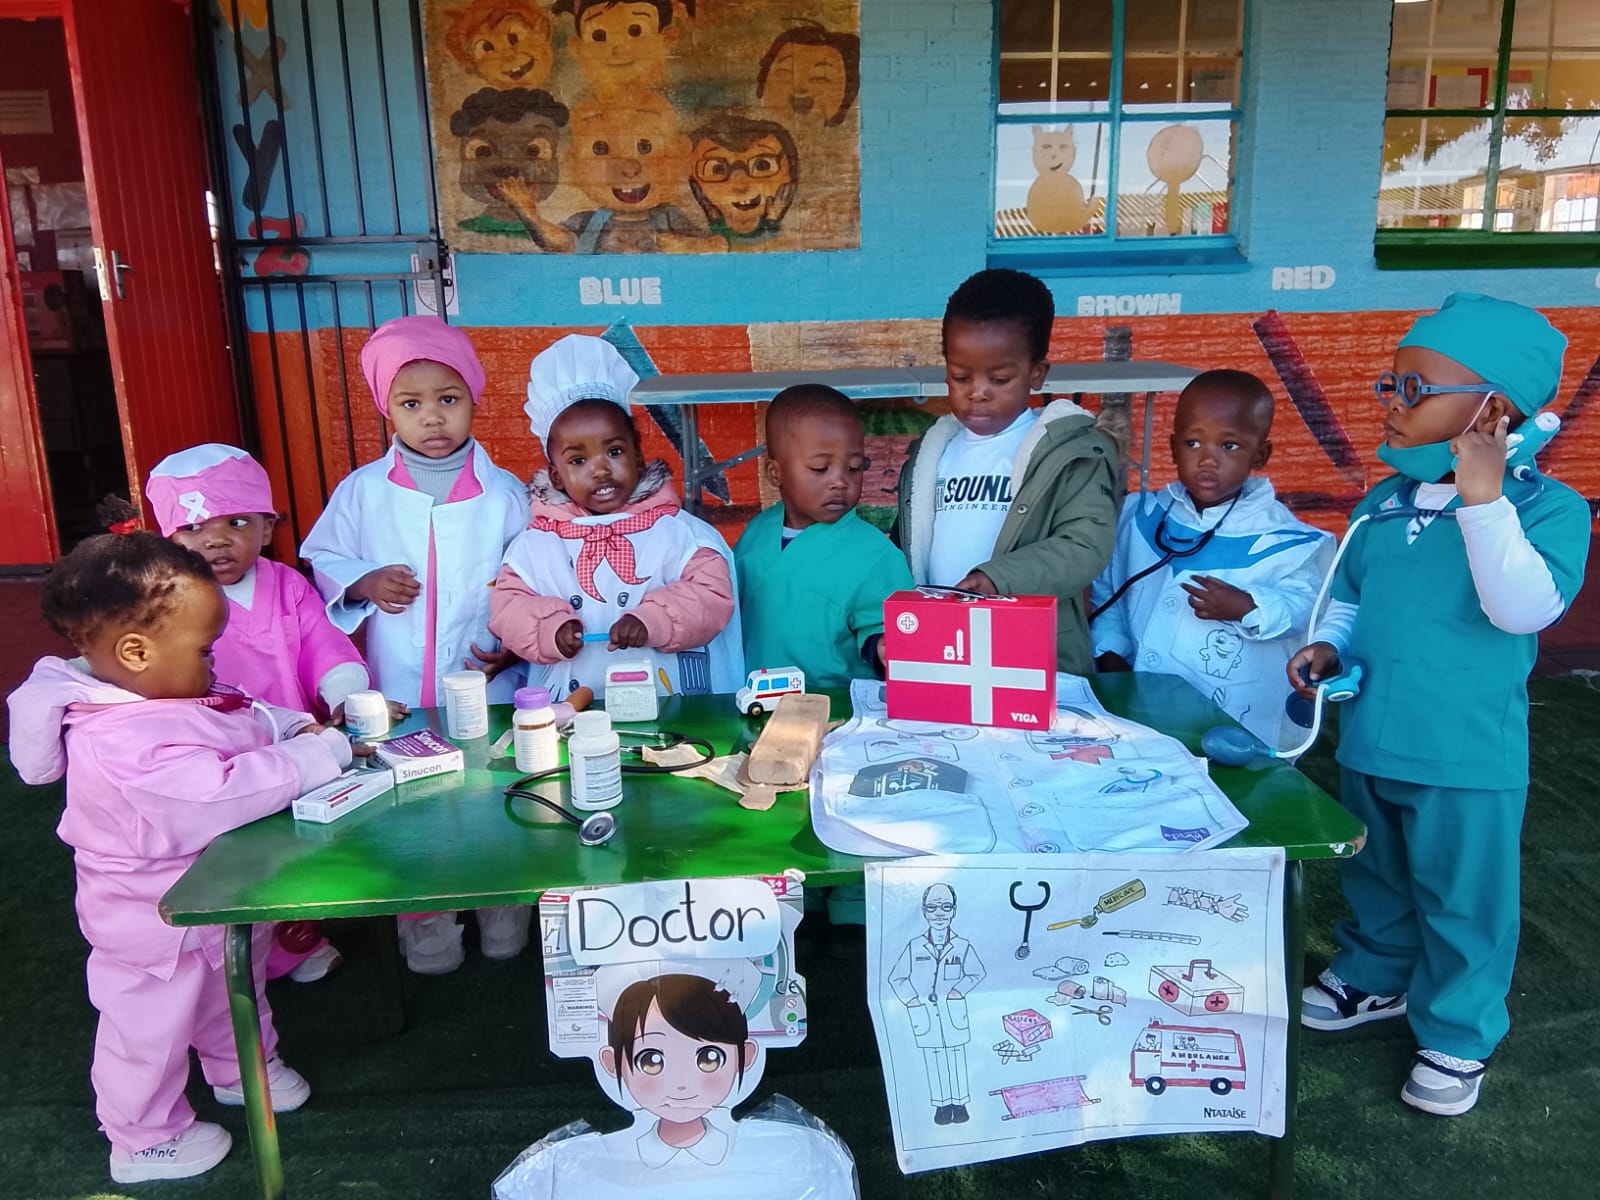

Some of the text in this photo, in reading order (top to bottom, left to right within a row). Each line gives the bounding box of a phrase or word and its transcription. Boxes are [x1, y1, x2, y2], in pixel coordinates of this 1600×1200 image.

[1271, 265, 1336, 290] RED
[579, 276, 662, 305] BLUE
[1077, 293, 1182, 317] BROWN
[944, 475, 1012, 503] SOUND
[1010, 712, 1039, 724] VIGA
[402, 764, 442, 778] Sinucon
[577, 881, 766, 952] Doctor
[1170, 1051, 1230, 1061] AMBULANCE
